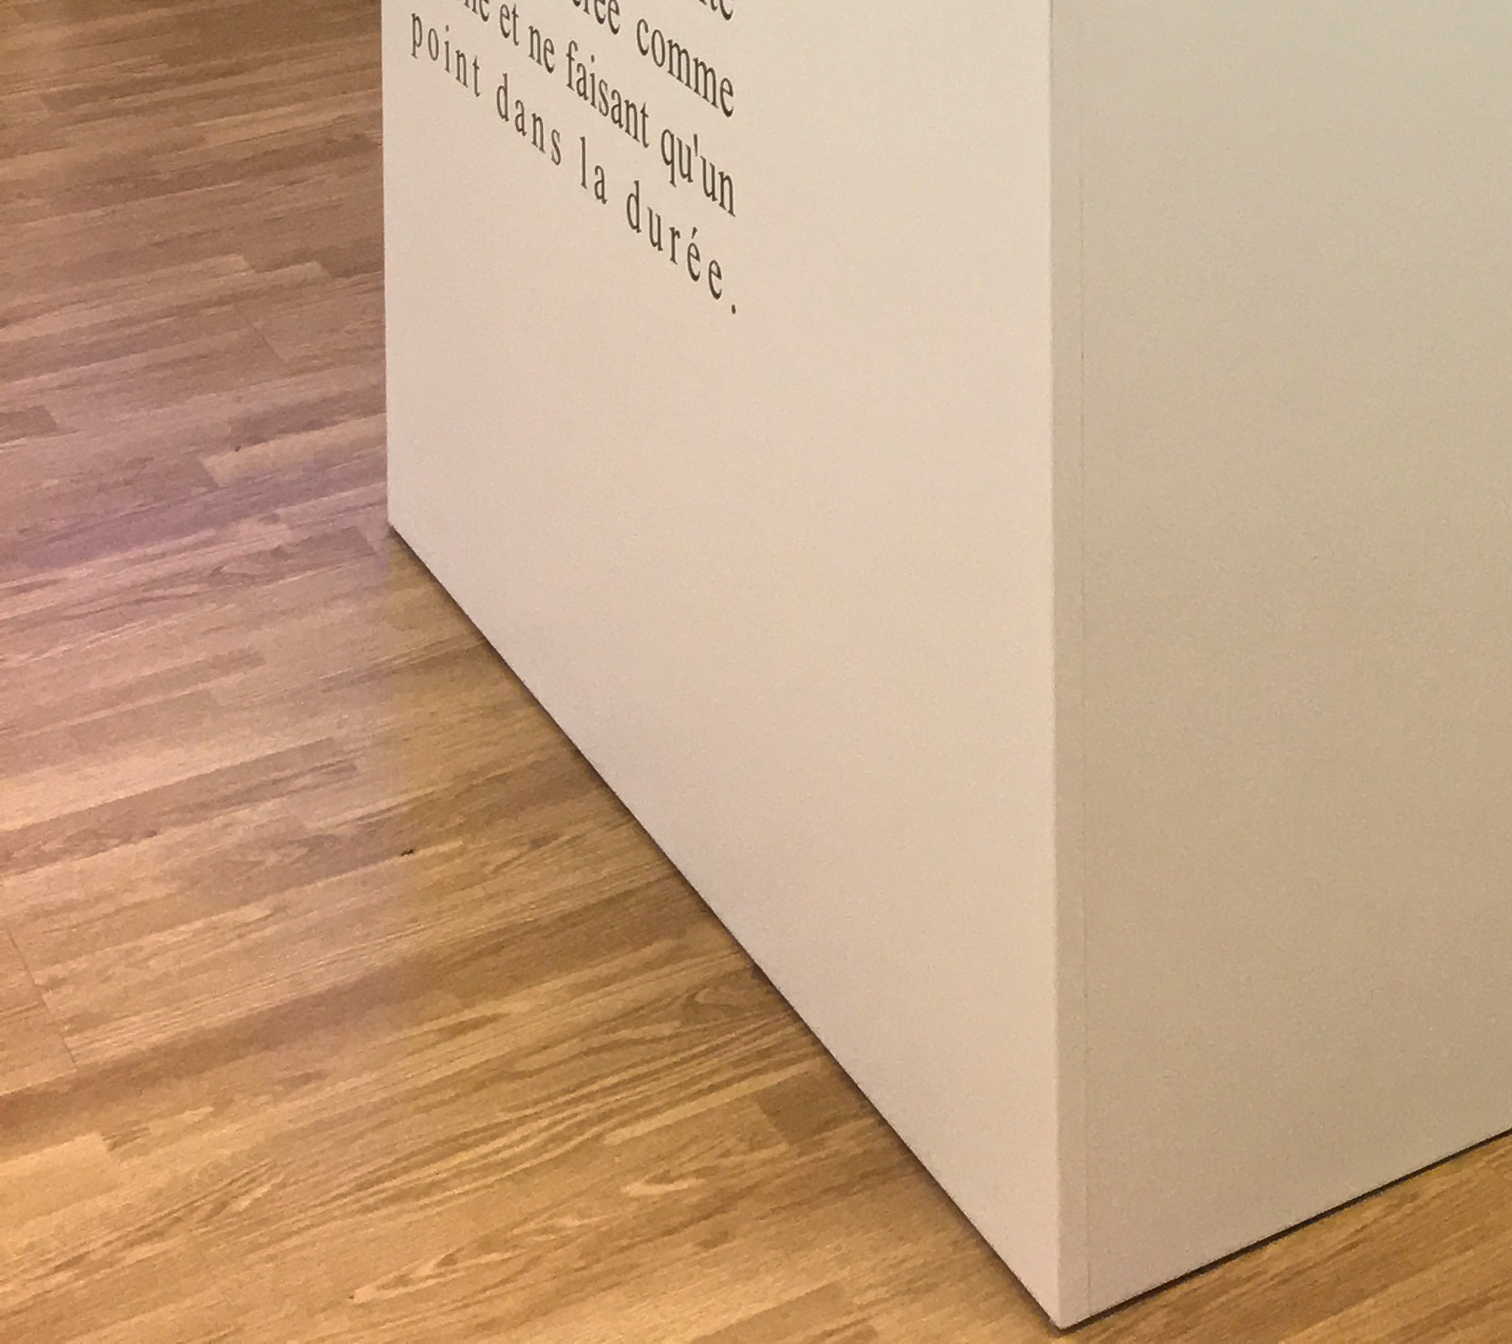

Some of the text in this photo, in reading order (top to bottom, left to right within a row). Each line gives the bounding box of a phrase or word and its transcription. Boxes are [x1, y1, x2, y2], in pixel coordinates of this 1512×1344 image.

[410, 12, 738, 314] point dans la durée.
[498, 1, 520, 48] et
[528, 23, 555, 74] ne
[566, 39, 649, 149] faisant
[660, 127, 736, 217] qu'un
[636, 14, 735, 119] comme
